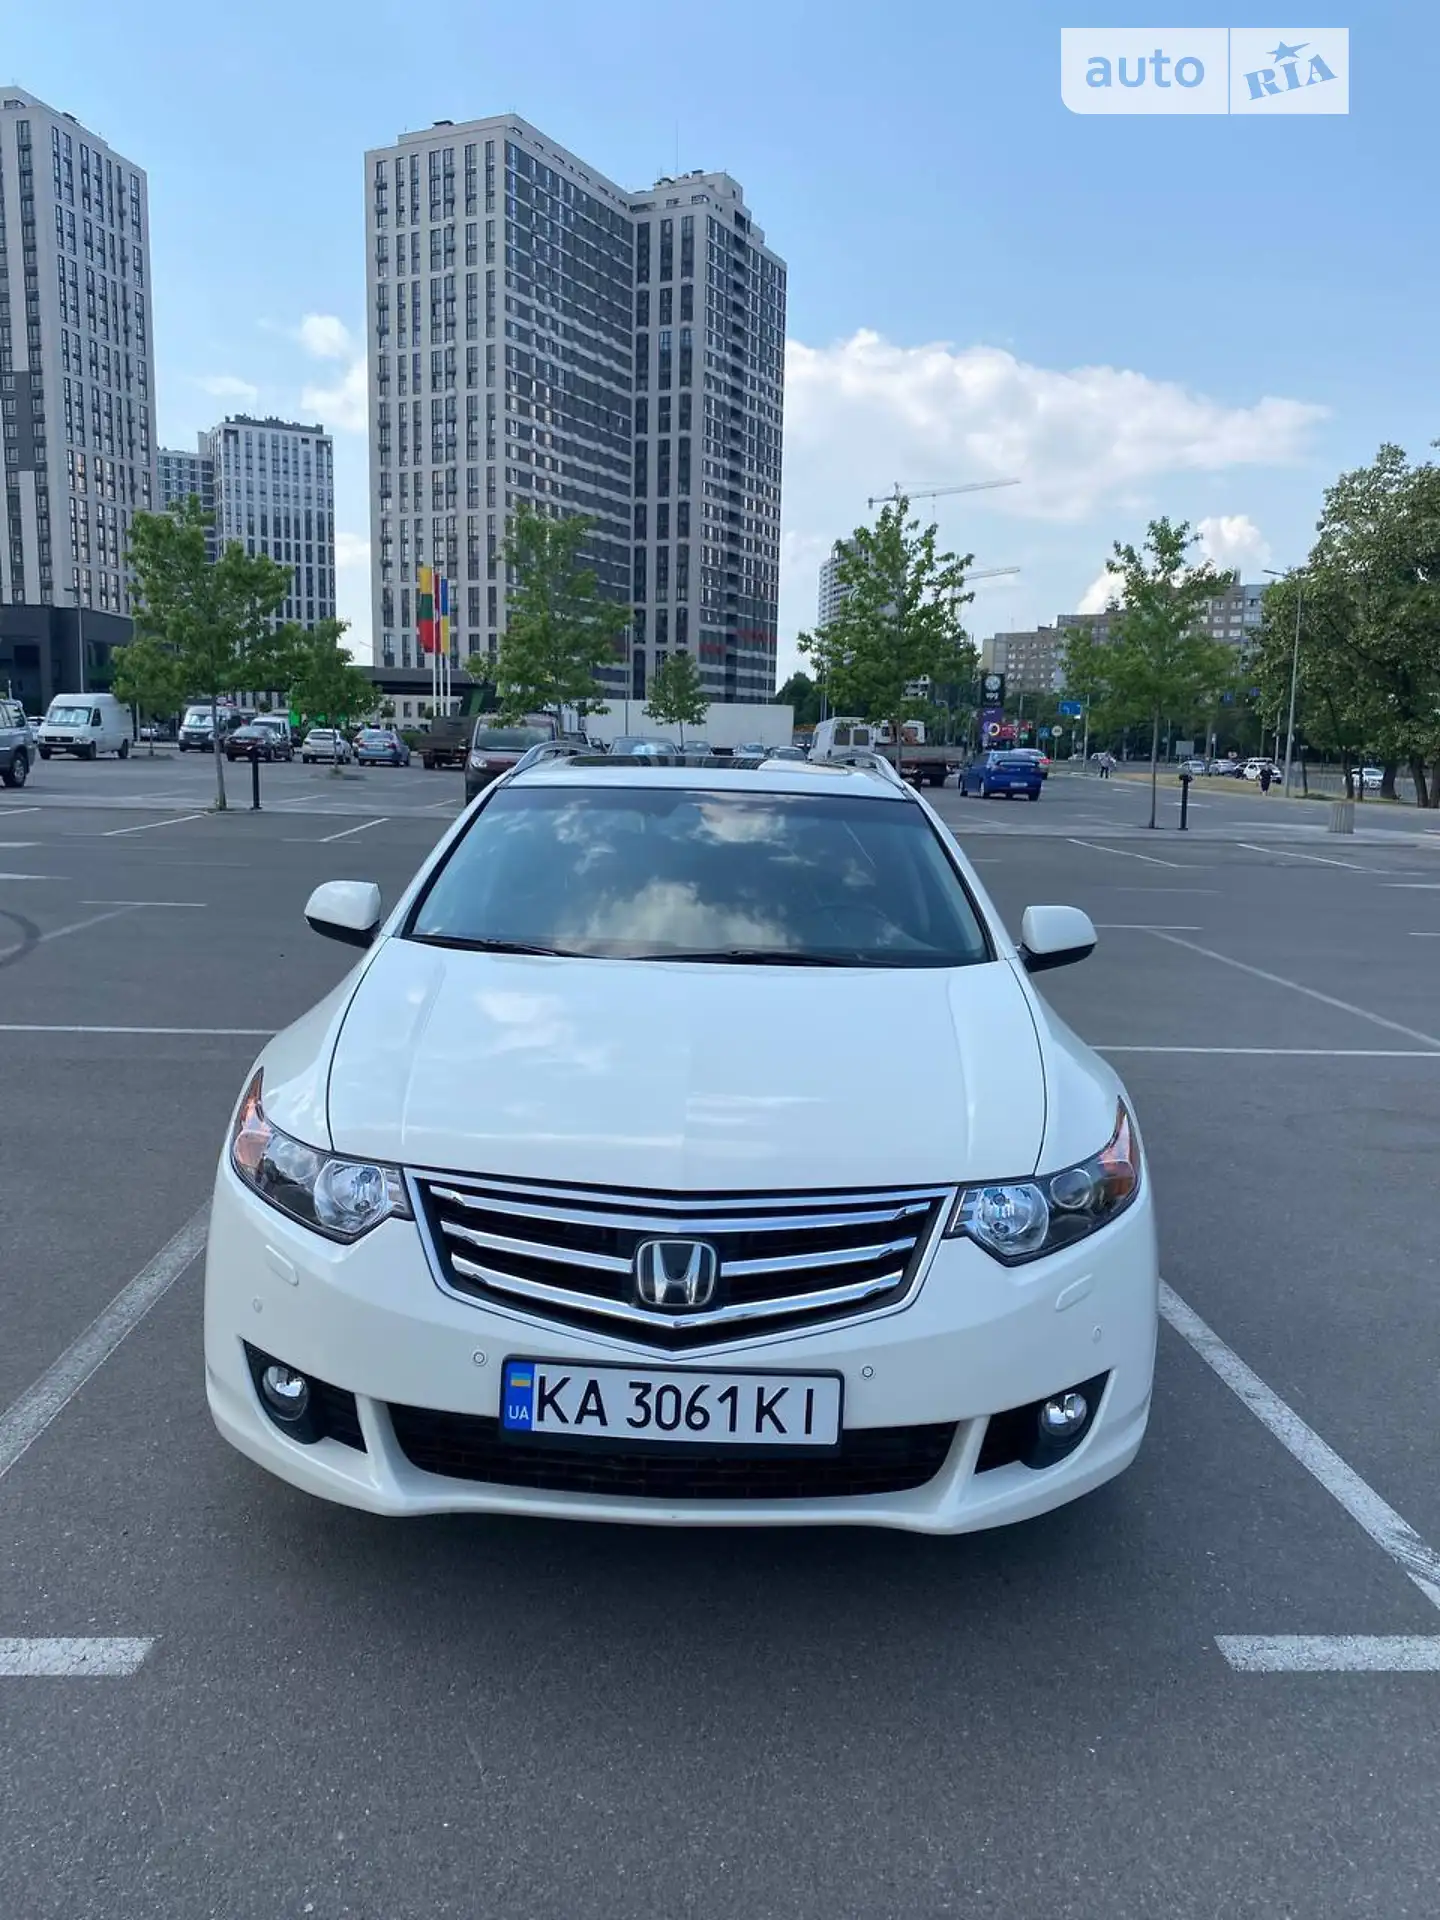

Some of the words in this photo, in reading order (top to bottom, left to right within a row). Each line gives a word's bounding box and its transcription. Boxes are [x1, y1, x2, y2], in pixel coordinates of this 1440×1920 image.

[508, 1405, 529, 1421] UA
[537, 1375, 608, 1426] KA
[626, 1382, 739, 1433] 3061
